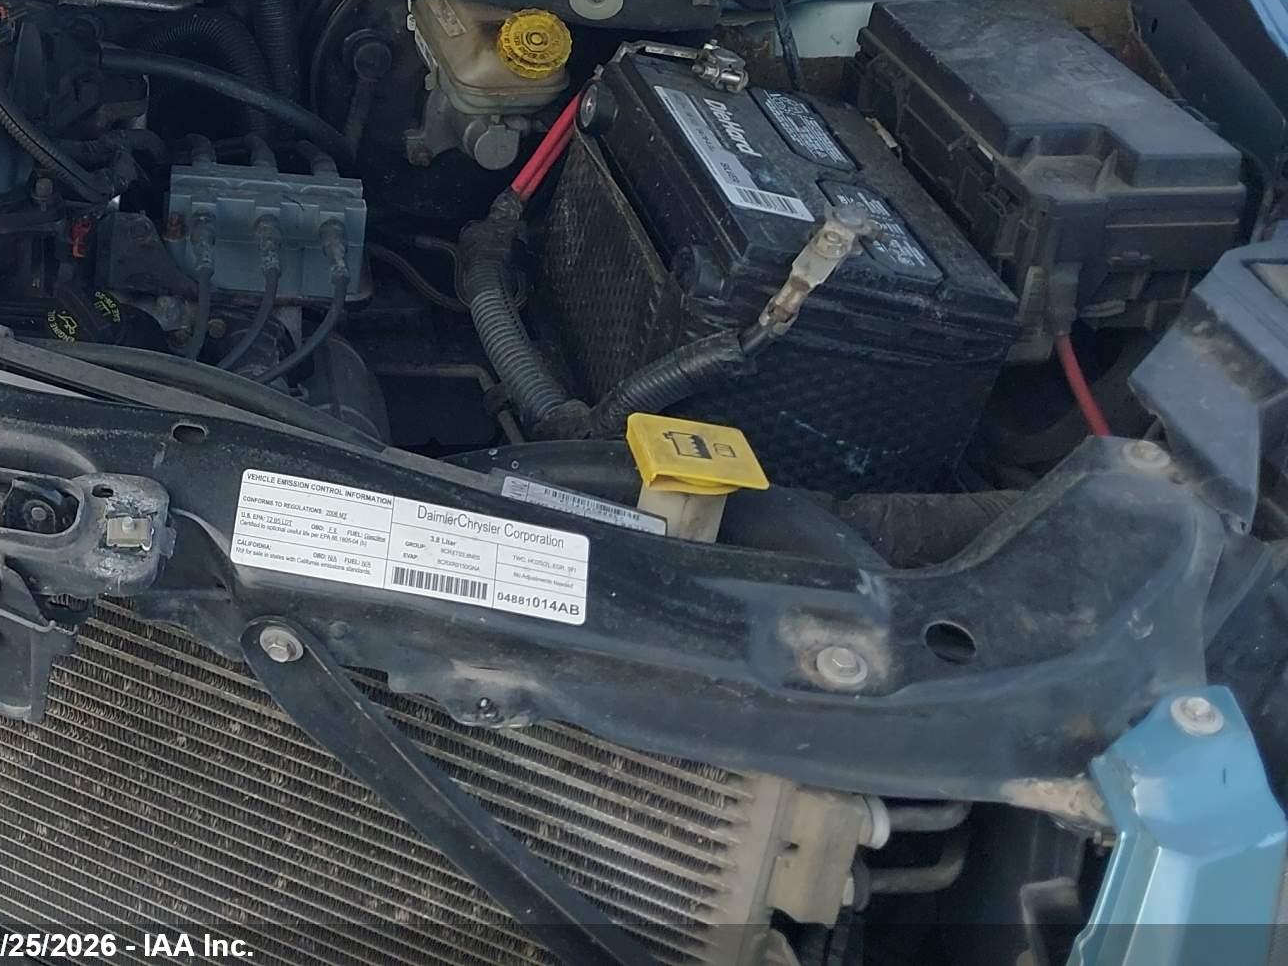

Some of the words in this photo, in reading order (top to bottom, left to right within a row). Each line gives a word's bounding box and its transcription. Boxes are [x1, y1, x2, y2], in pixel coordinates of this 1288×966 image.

[704, 98, 762, 158] DieHard
[242, 495, 273, 505] CONFORMS
[247, 472, 275, 483] VEHICLE
[276, 477, 309, 489] EMISSION
[310, 483, 343, 495] CONTROL
[344, 490, 392, 504] INFORMATION
[417, 504, 500, 536] DaimlerChrysler
[503, 522, 564, 549] Corporation
[497, 591, 579, 616] 04881014AB
